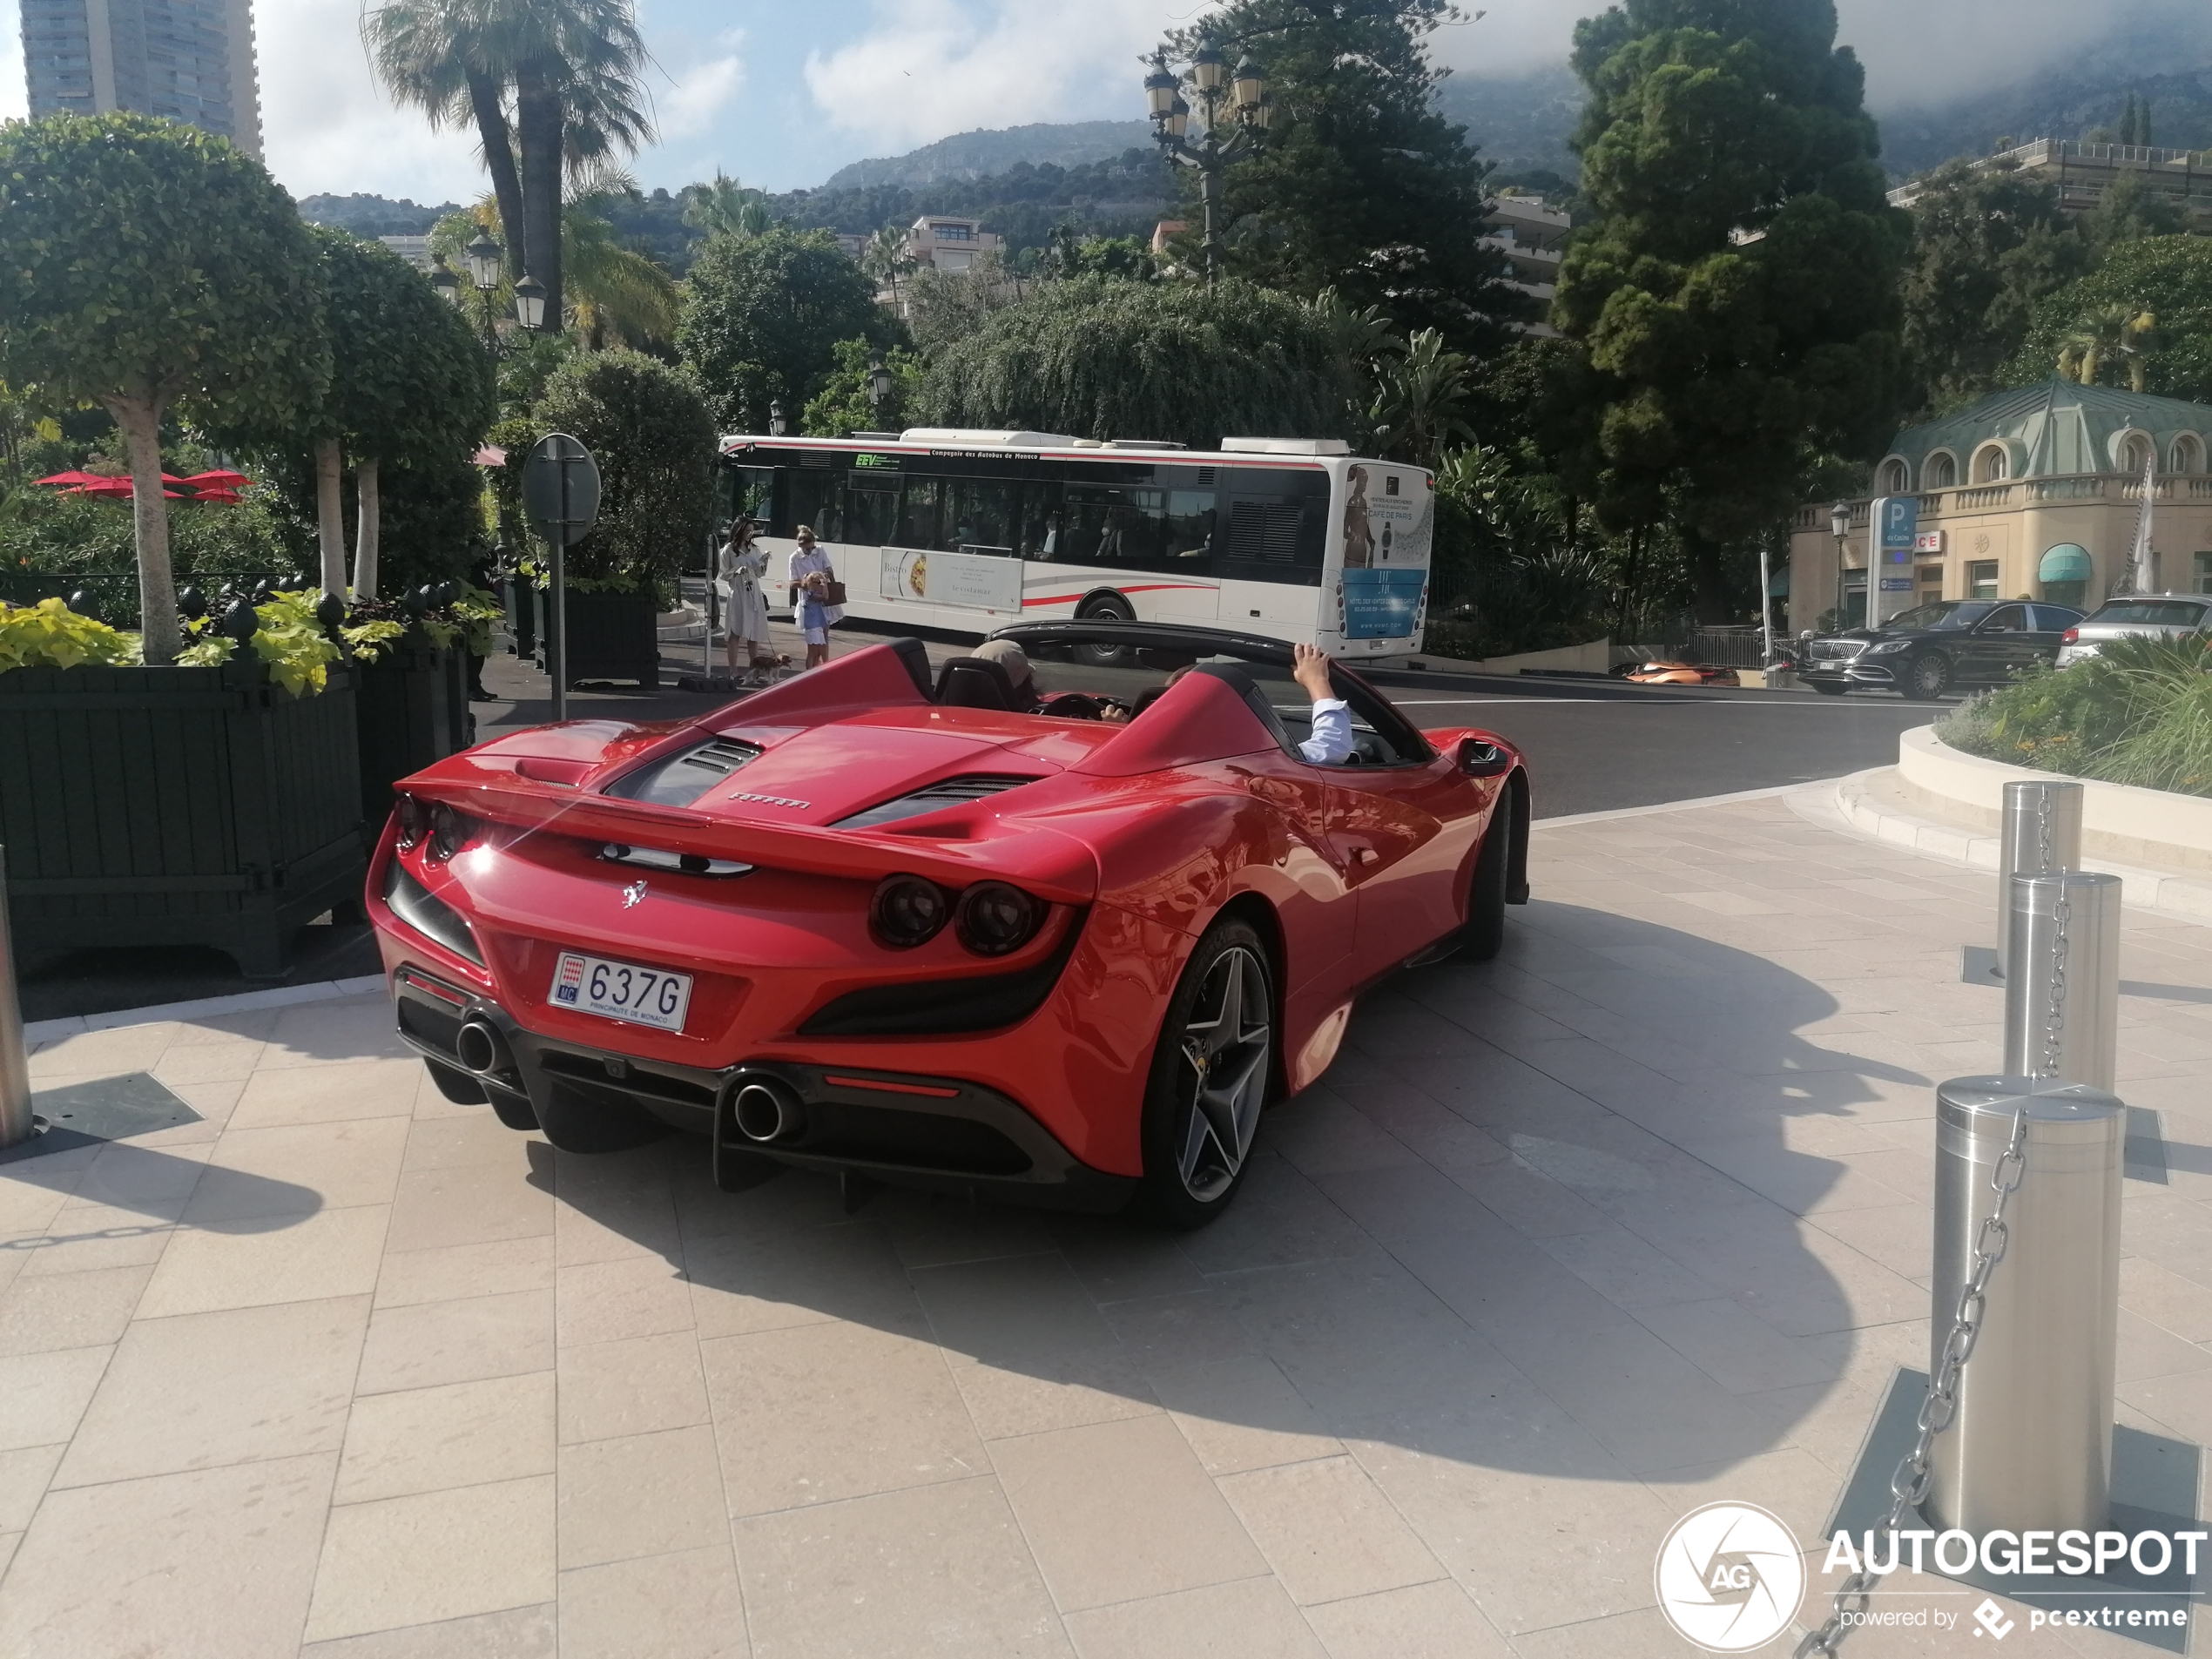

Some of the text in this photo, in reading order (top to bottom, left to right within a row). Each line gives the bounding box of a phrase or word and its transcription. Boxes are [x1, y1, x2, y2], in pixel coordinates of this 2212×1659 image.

[855, 454, 877, 466] EEV
[931, 449, 963, 458] Compagnie
[1891, 503, 1905, 529] P
[728, 792, 811, 810] Ferrari
[560, 986, 575, 1001] MC
[590, 963, 680, 1015] 637G
[640, 1012, 668, 1024] MONACO
